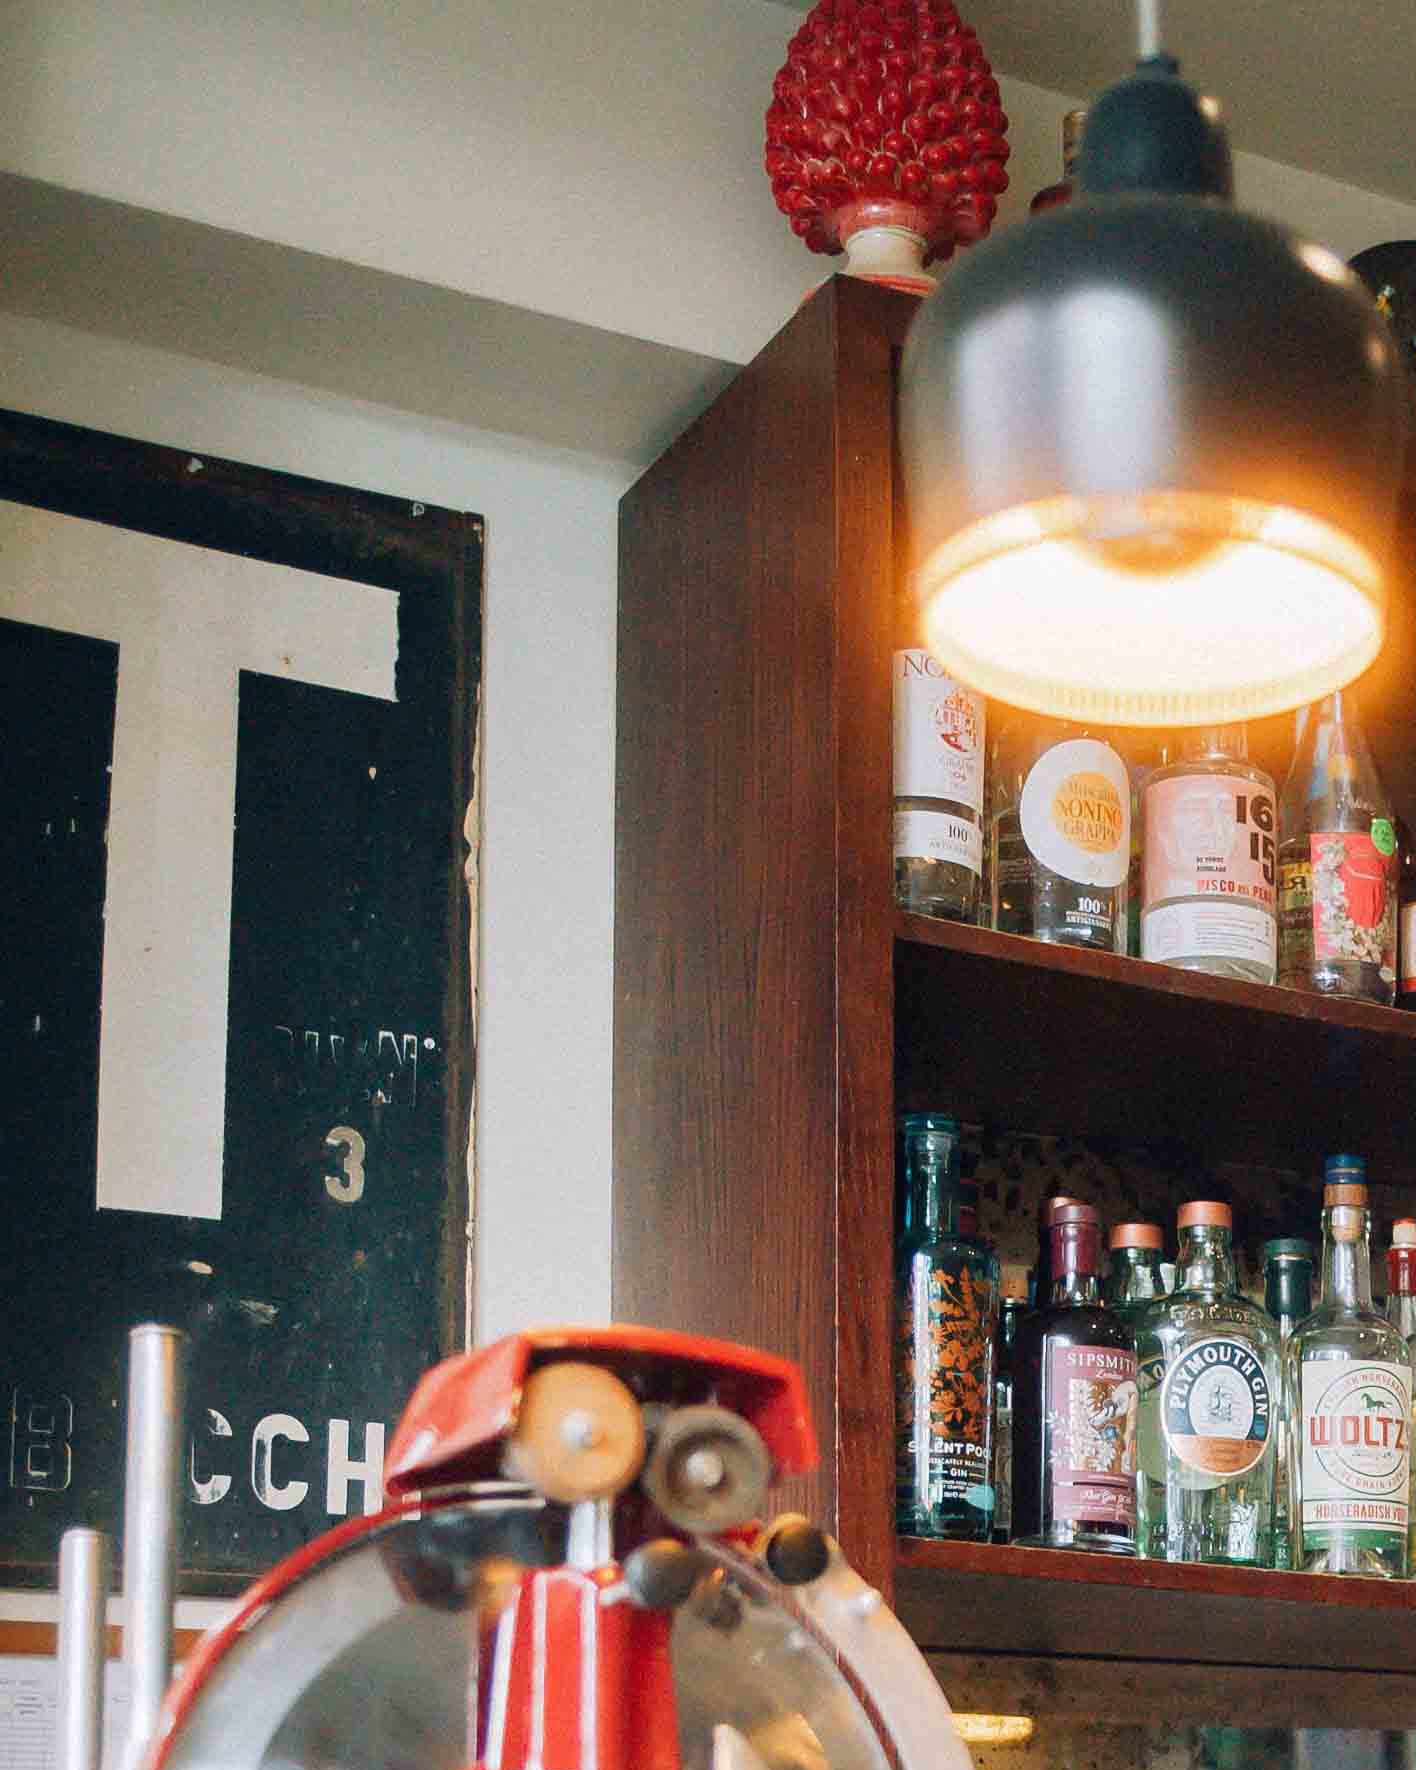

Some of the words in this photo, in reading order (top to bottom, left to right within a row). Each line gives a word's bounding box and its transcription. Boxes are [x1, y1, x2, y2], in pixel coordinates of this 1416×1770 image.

[902, 654, 951, 681] NO
[1056, 799, 1122, 828] NONINO
[1236, 795, 1275, 833] 16
[324, 1126, 366, 1203] 3
[1168, 1345, 1255, 1409] PLYMOUTH
[1250, 1374, 1270, 1416] GIN
[1310, 1415, 1408, 1451] WOLTZ
[950, 1467, 968, 1478] GIN
[1313, 1502, 1391, 1521] HORSERADISH
